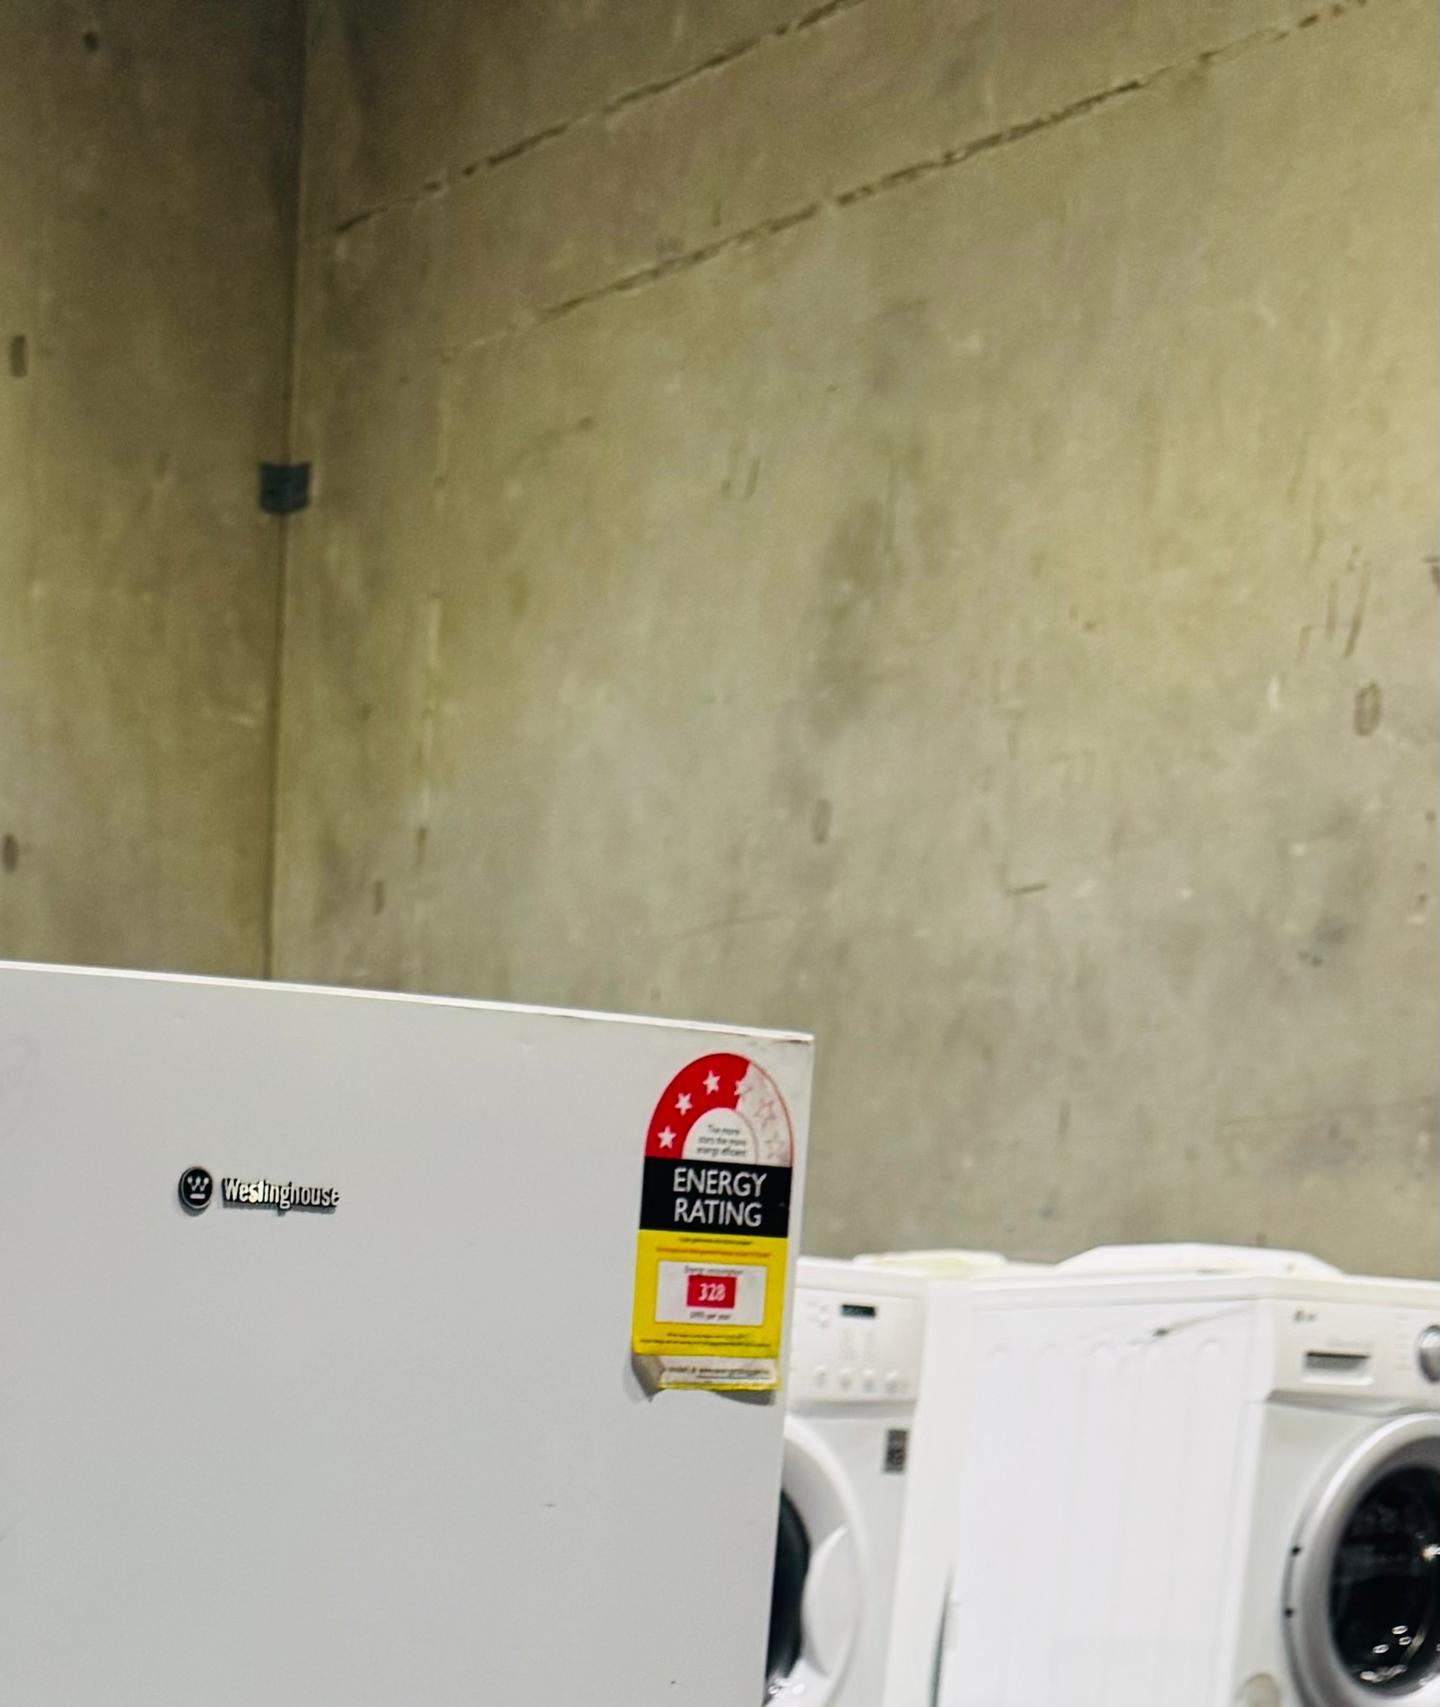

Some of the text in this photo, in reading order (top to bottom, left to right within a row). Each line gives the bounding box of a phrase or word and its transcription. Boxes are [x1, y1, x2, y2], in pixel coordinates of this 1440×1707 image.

[222, 1177, 341, 1210] Westinghouse
[673, 1166, 767, 1198] ENERGY
[674, 1197, 763, 1227] RATING
